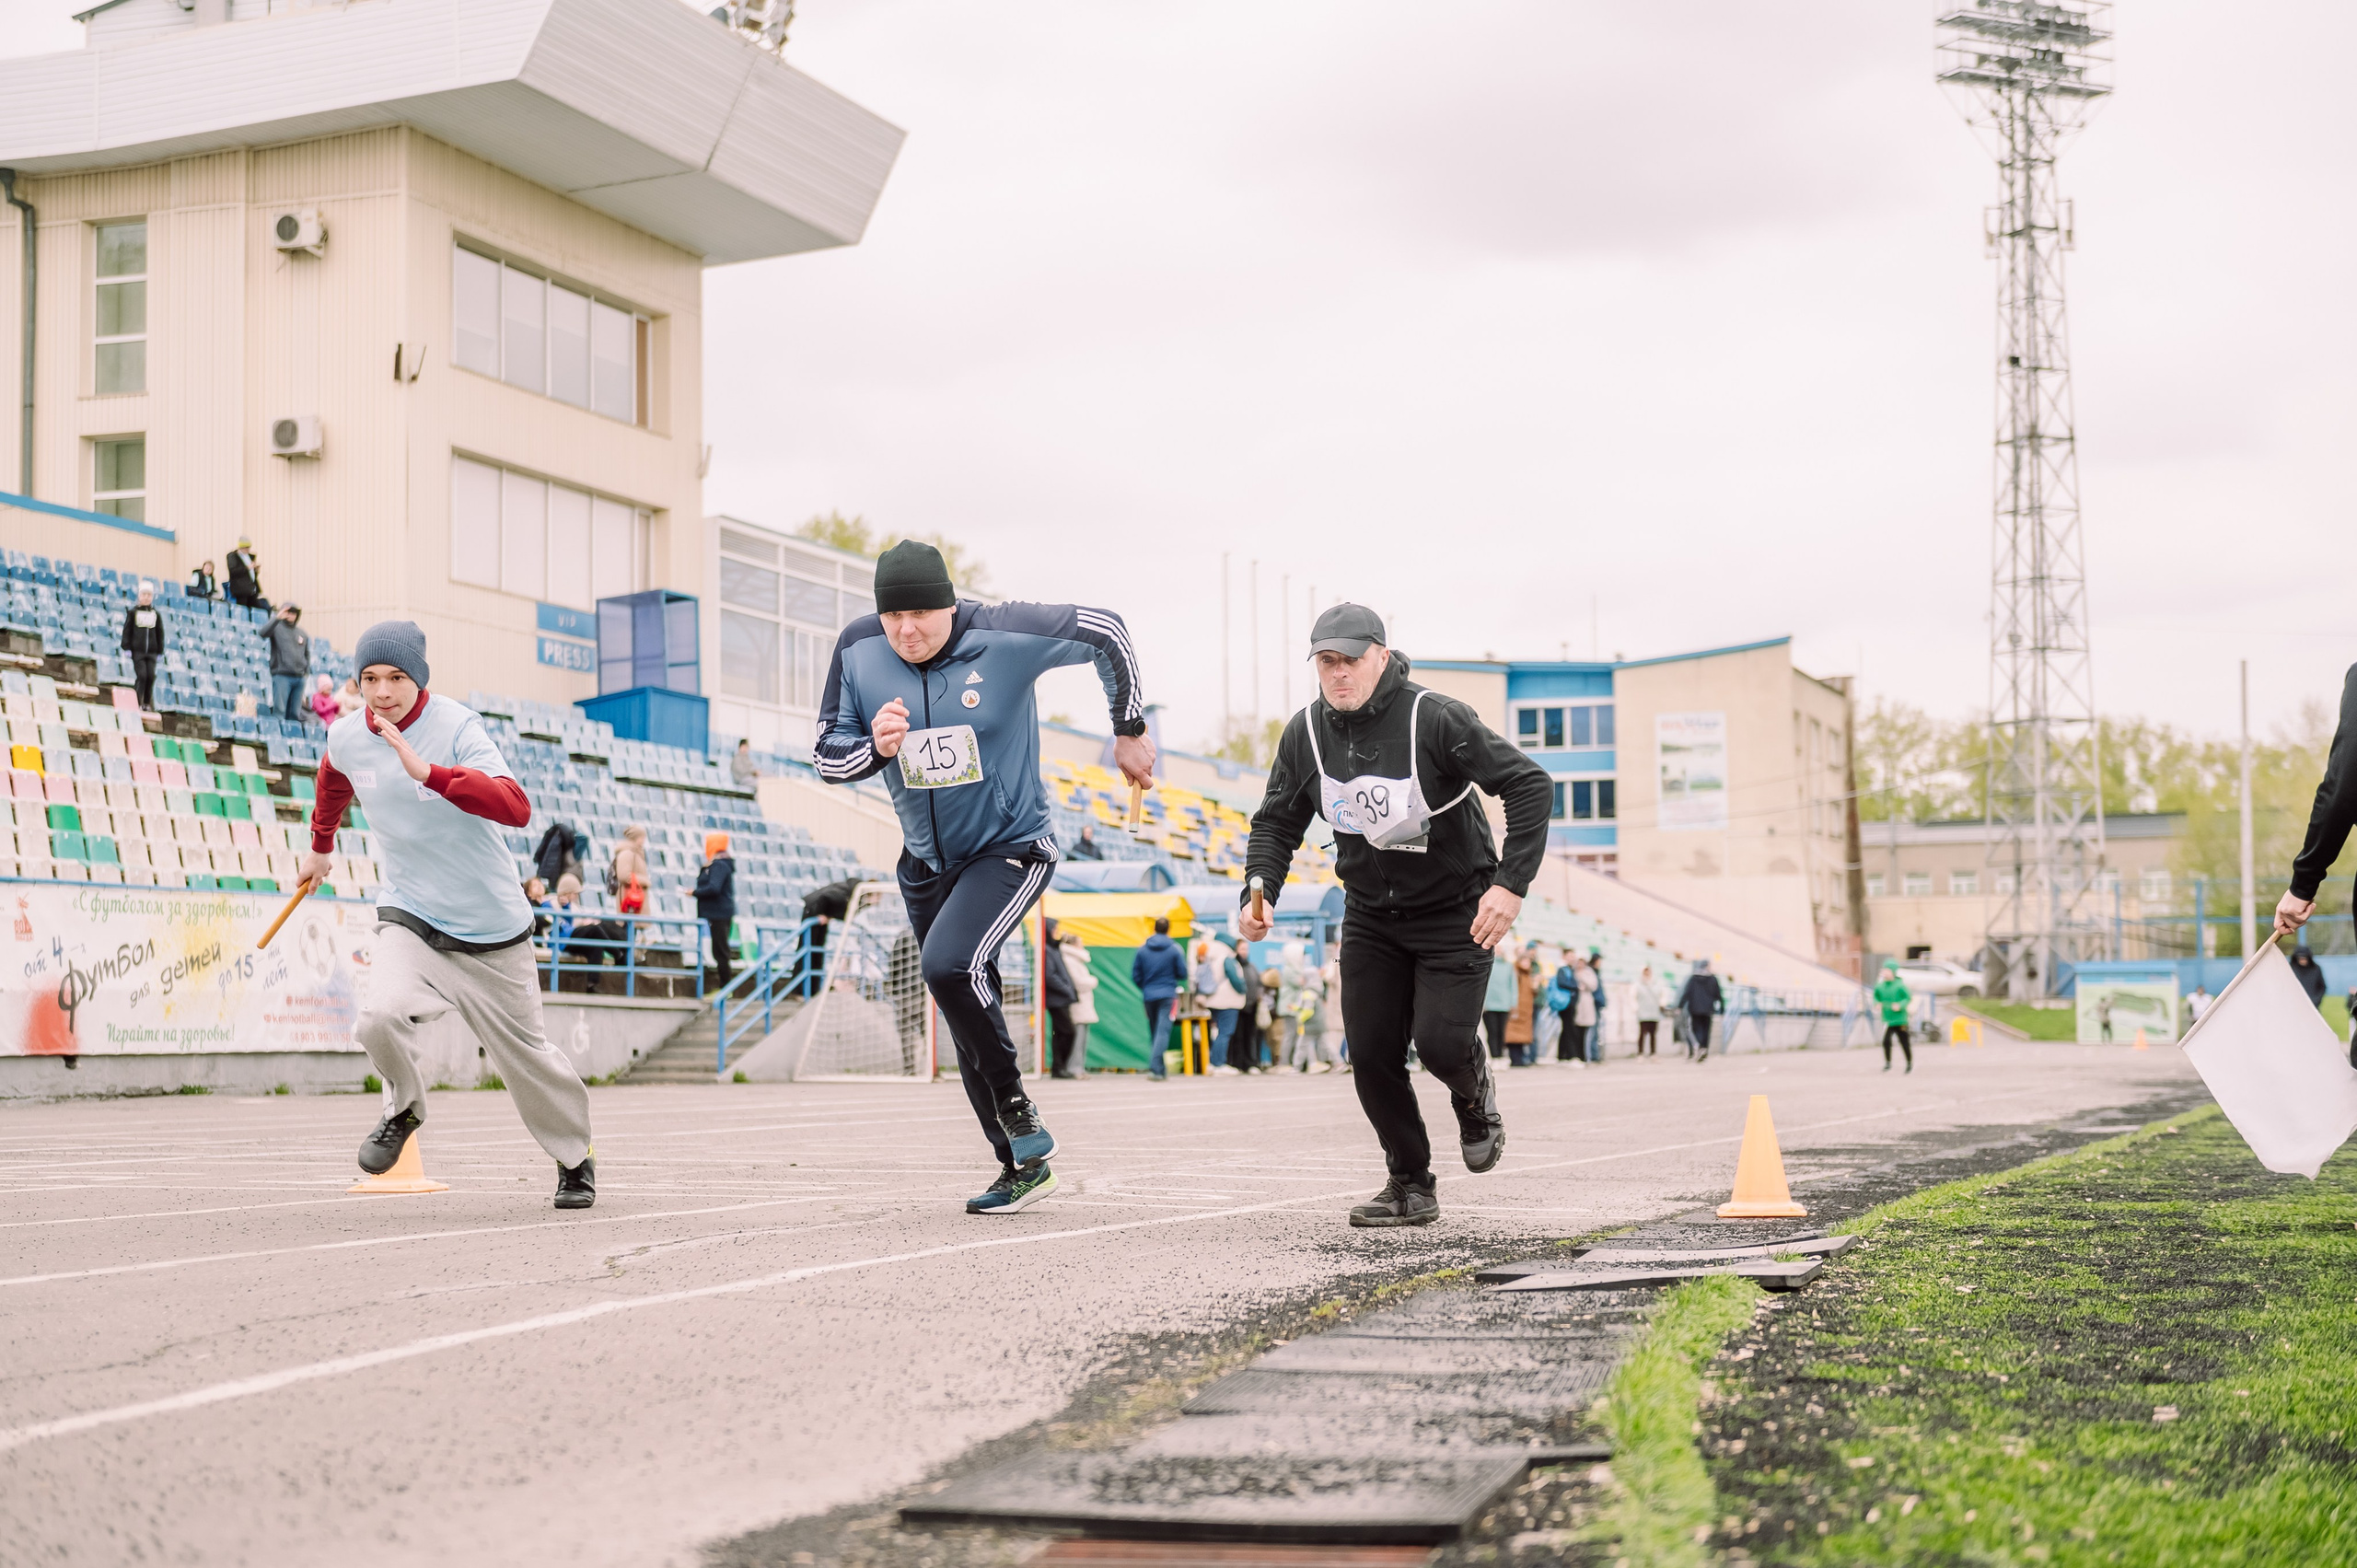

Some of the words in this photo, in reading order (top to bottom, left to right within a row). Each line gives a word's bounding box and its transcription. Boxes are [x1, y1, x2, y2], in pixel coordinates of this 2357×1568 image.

[544, 640, 590, 670] PRESS
[919, 735, 957, 771] 15
[355, 775, 372, 784] 1019
[1356, 784, 1389, 824] 39
[91, 891, 164, 923] футболом
[167, 901, 182, 925] за
[185, 899, 263, 926] здоровьем!»
[25, 949, 47, 978] от
[130, 982, 150, 1009] для
[160, 941, 222, 995] детей
[262, 958, 287, 992] лет
[218, 969, 233, 998] до
[107, 1022, 160, 1051] Играйте
[163, 1028, 178, 1042] на
[180, 1023, 236, 1051] здоровье!
